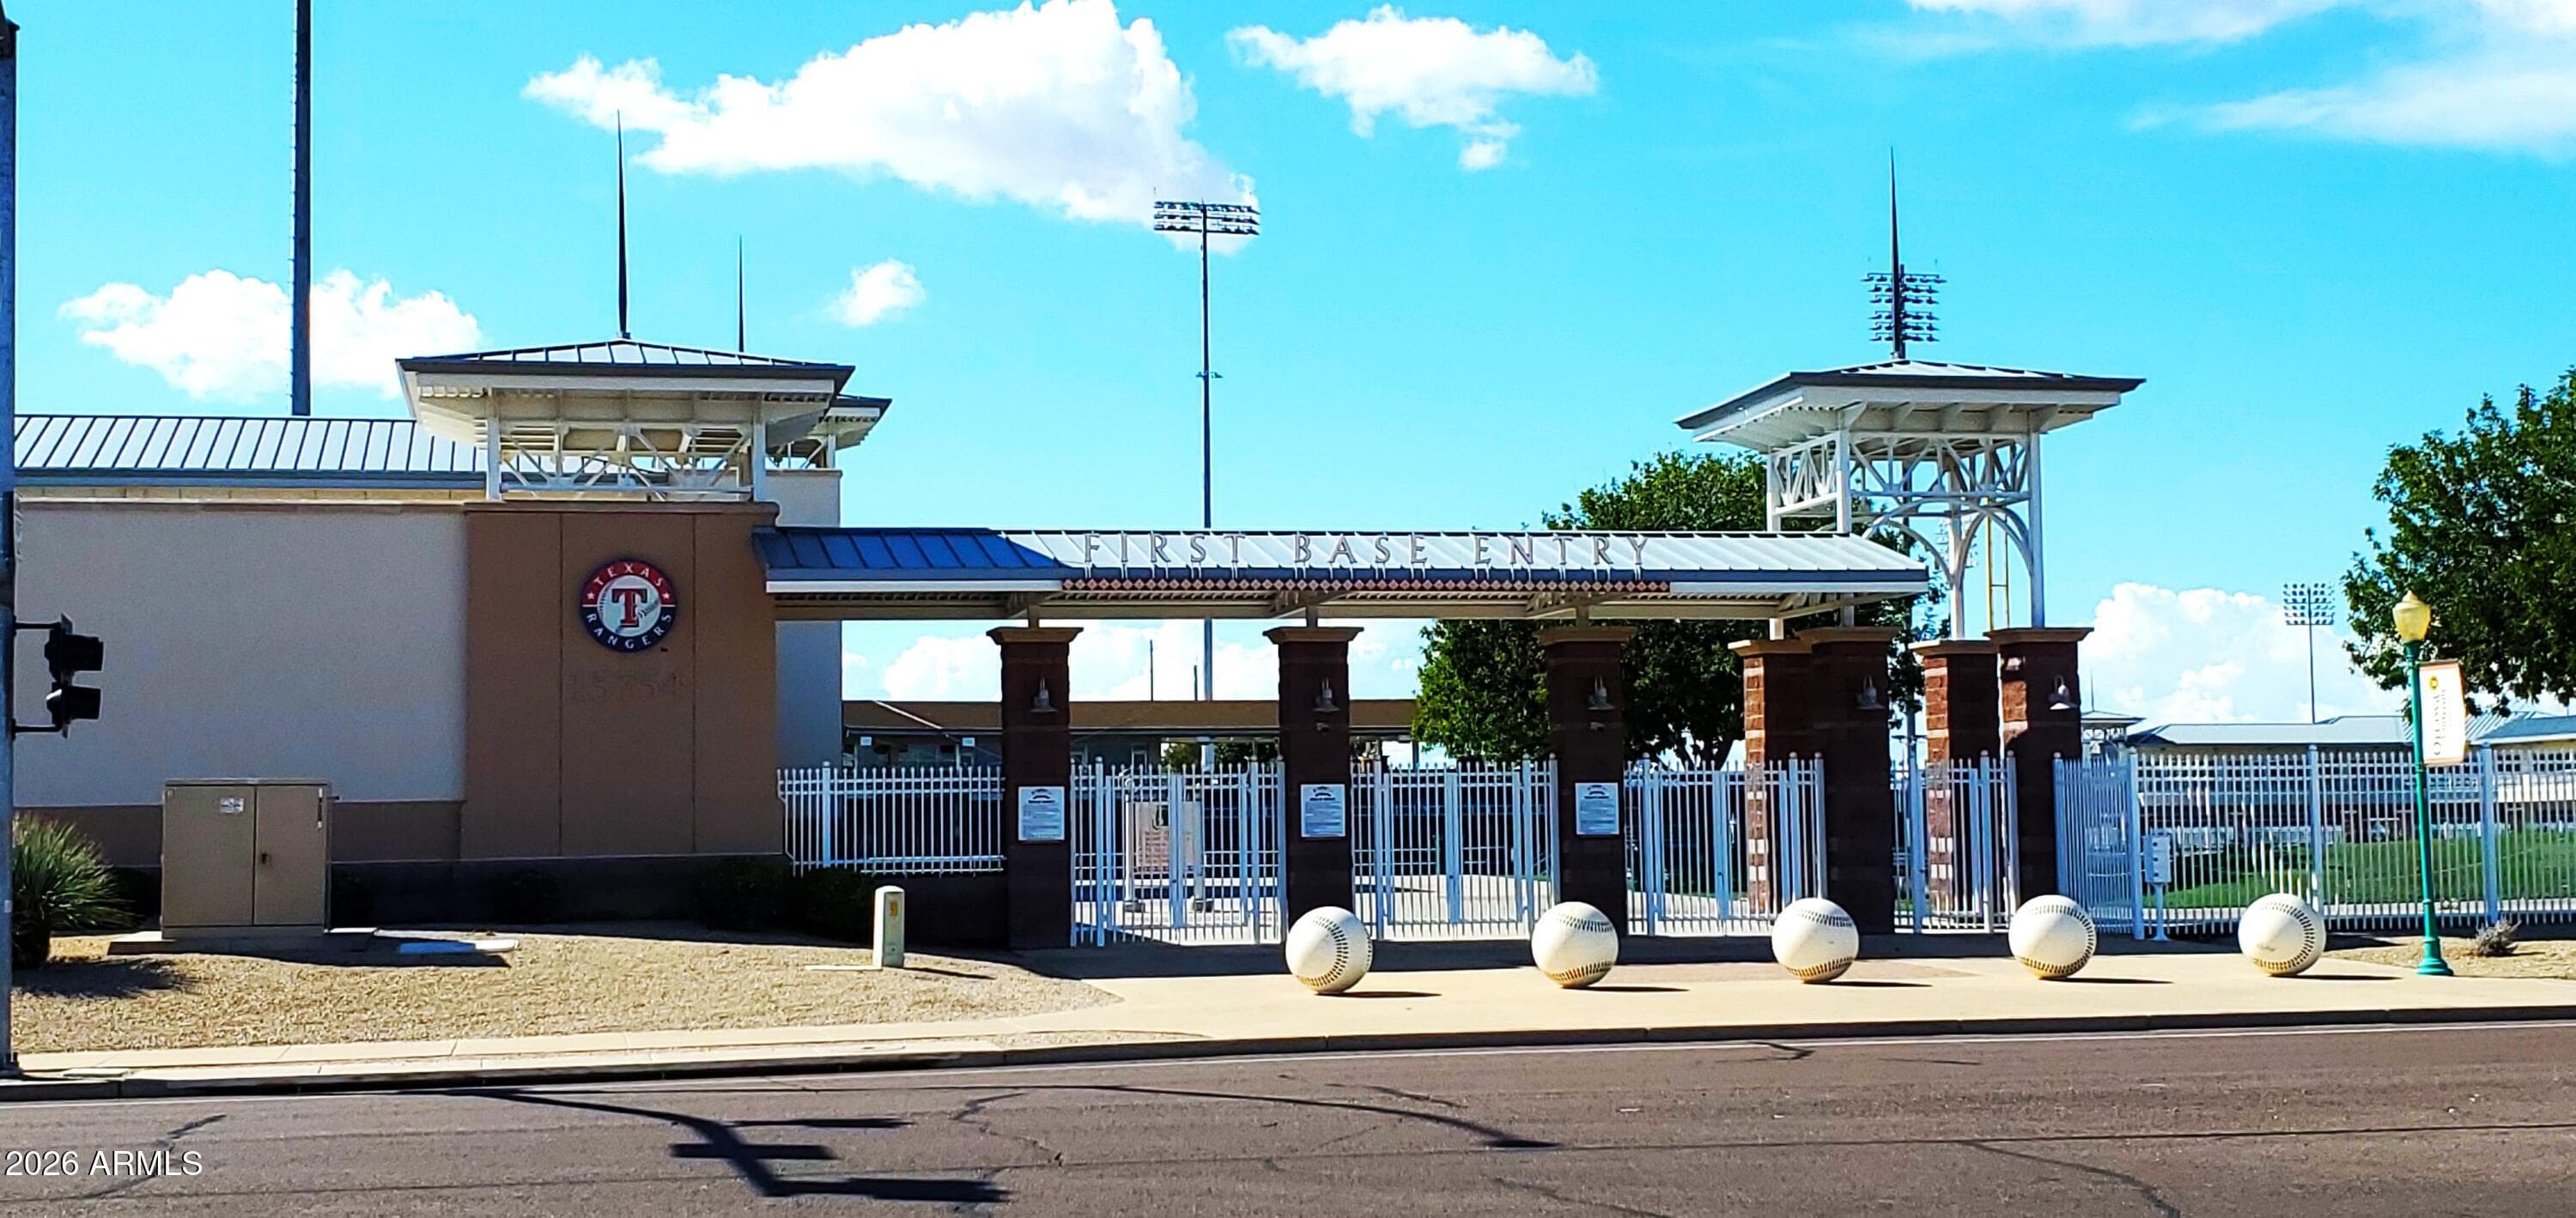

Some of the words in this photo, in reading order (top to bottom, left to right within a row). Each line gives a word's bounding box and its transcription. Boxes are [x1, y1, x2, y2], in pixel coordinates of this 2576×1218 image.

[1084, 533, 1245, 563] FIRST
[1293, 533, 1428, 565] BASE
[1473, 534, 1648, 566] ENTRY
[593, 563, 665, 587] TEXAS
[611, 588, 648, 627] T
[586, 613, 672, 649] RANGERS
